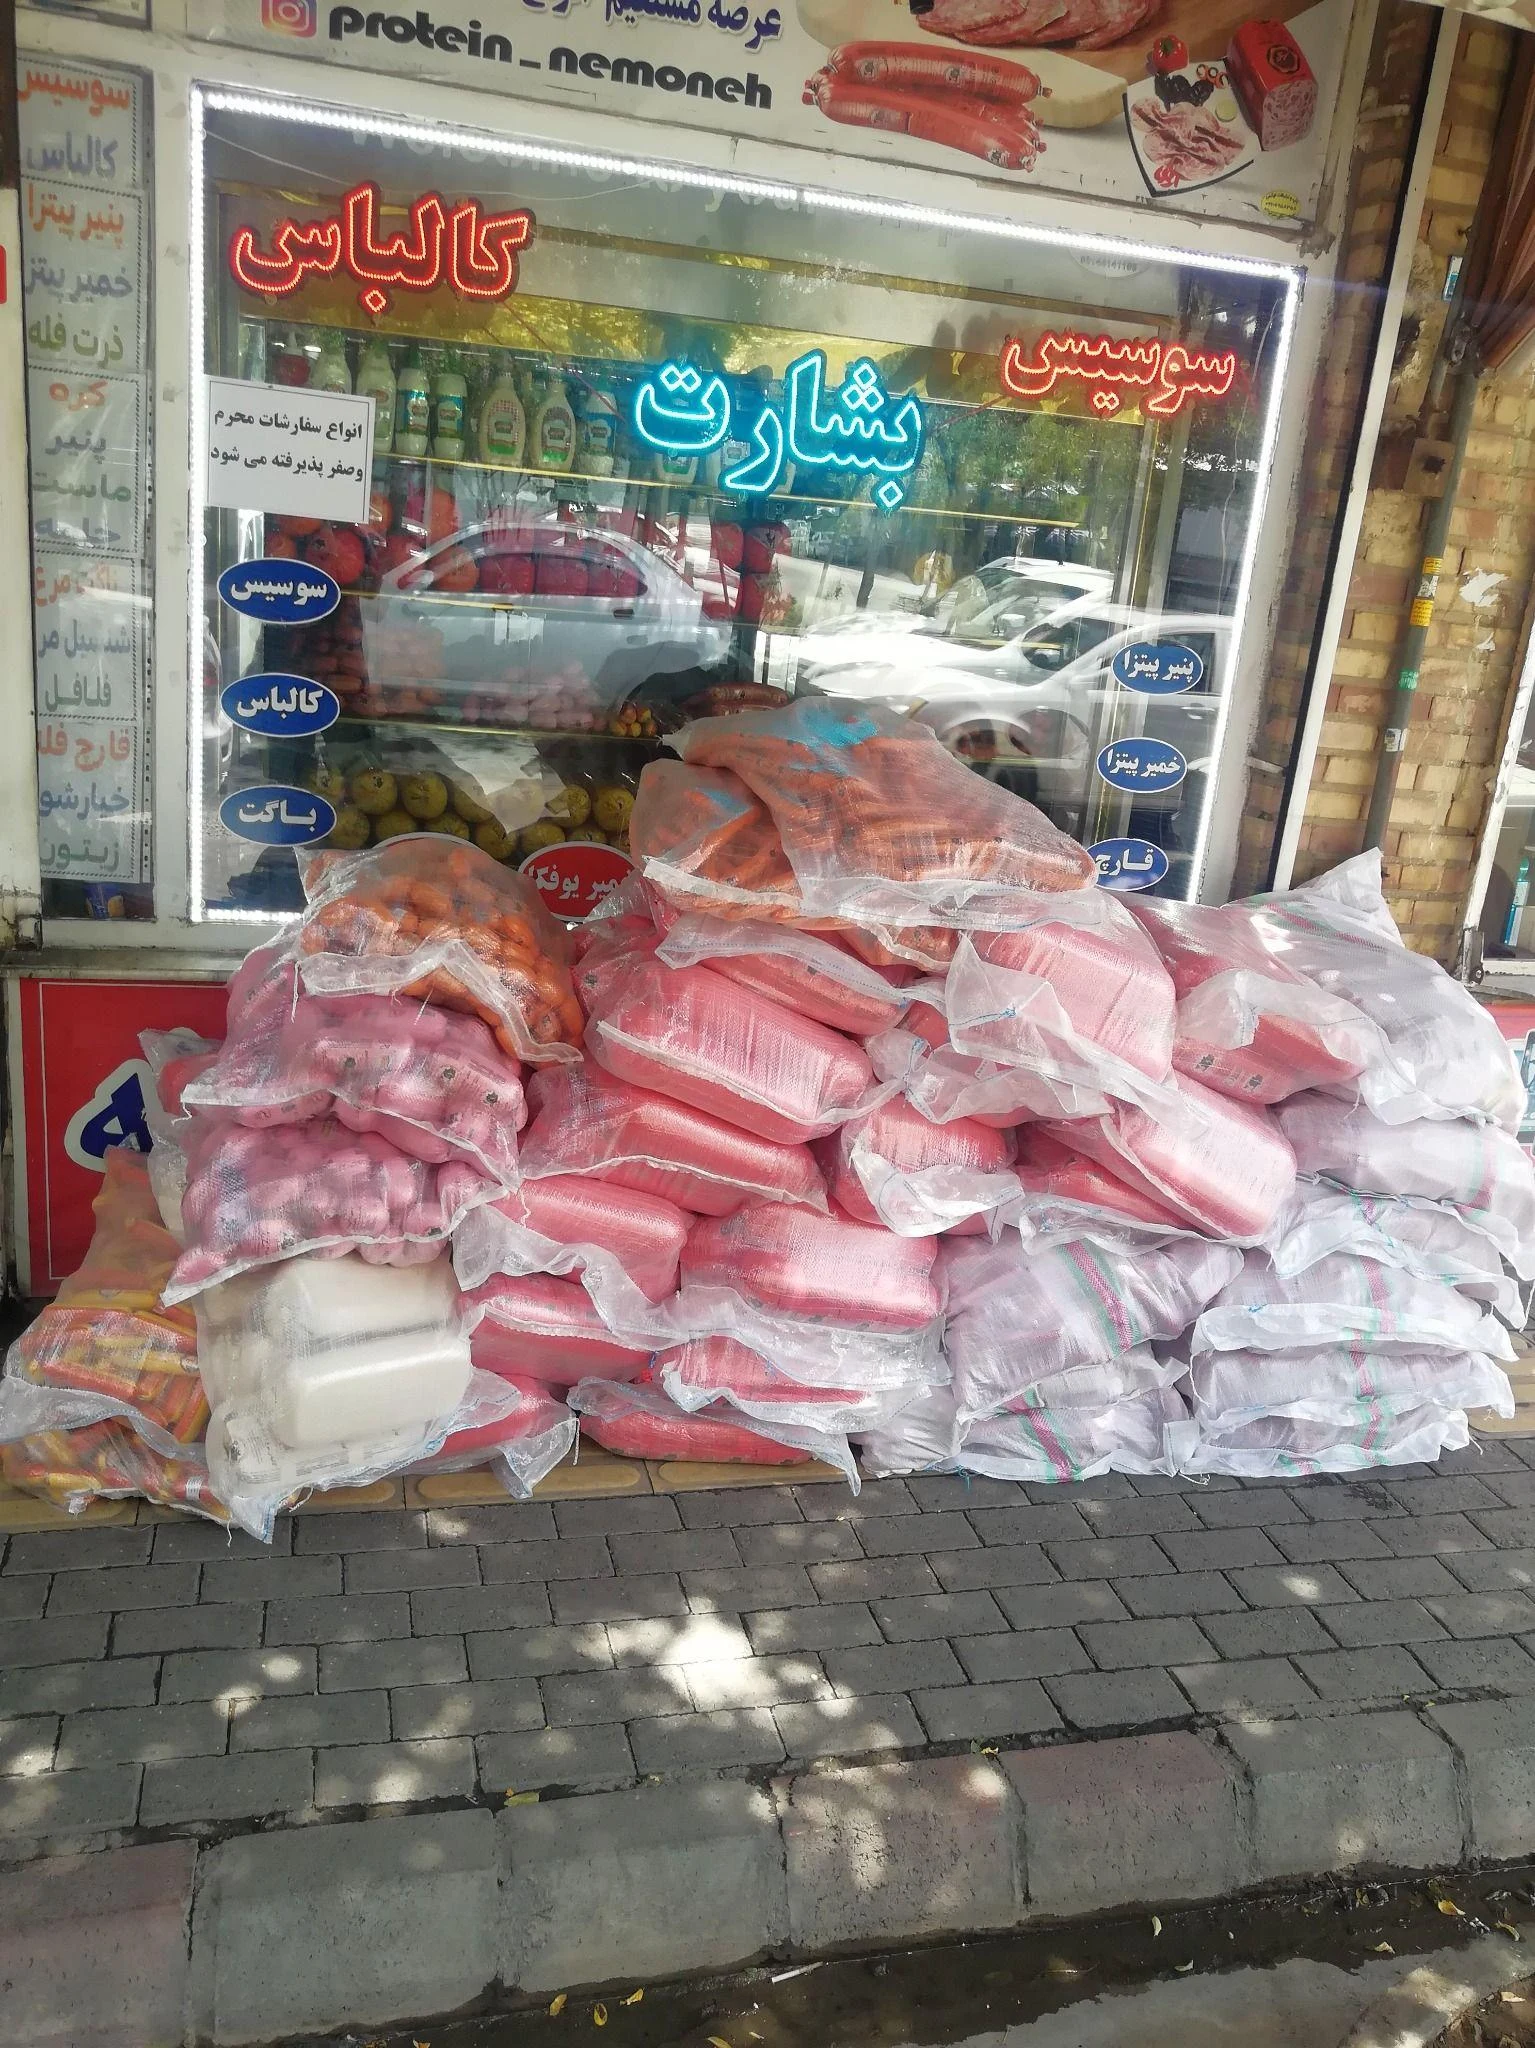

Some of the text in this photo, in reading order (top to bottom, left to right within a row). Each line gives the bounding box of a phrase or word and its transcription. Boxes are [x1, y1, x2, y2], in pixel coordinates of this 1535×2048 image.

[17, 70, 131, 117] سوسیس
[26, 132, 118, 180] کالباس
[28, 183, 125, 249] پنیر پیتزا
[232, 182, 534, 314] کالباس
[25, 258, 134, 304] خمیر پیتز
[28, 313, 124, 369] ذرت فله
[1003, 334, 1236, 414] سوسیس
[50, 380, 108, 412] کره
[214, 409, 363, 442] انواع سفارشات محرم
[634, 347, 923, 510] بشارت
[45, 431, 107, 464] پنیر
[210, 446, 240, 465] شود
[244, 455, 267, 469] می
[271, 452, 324, 478] پذیرفته
[230, 578, 328, 605] سوسیس
[38, 629, 60, 658] مر
[1123, 649, 1195, 683] پنیر پیتزا
[45, 673, 112, 712] فلافل
[236, 685, 324, 719] کالباس
[74, 728, 132, 773] قارچ
[1106, 748, 1181, 777] خمیر پیتزا
[238, 799, 318, 832] باگت
[40, 837, 120, 872] زیتون
[1095, 847, 1155, 876] قارچ
[585, 869, 632, 900] میر
